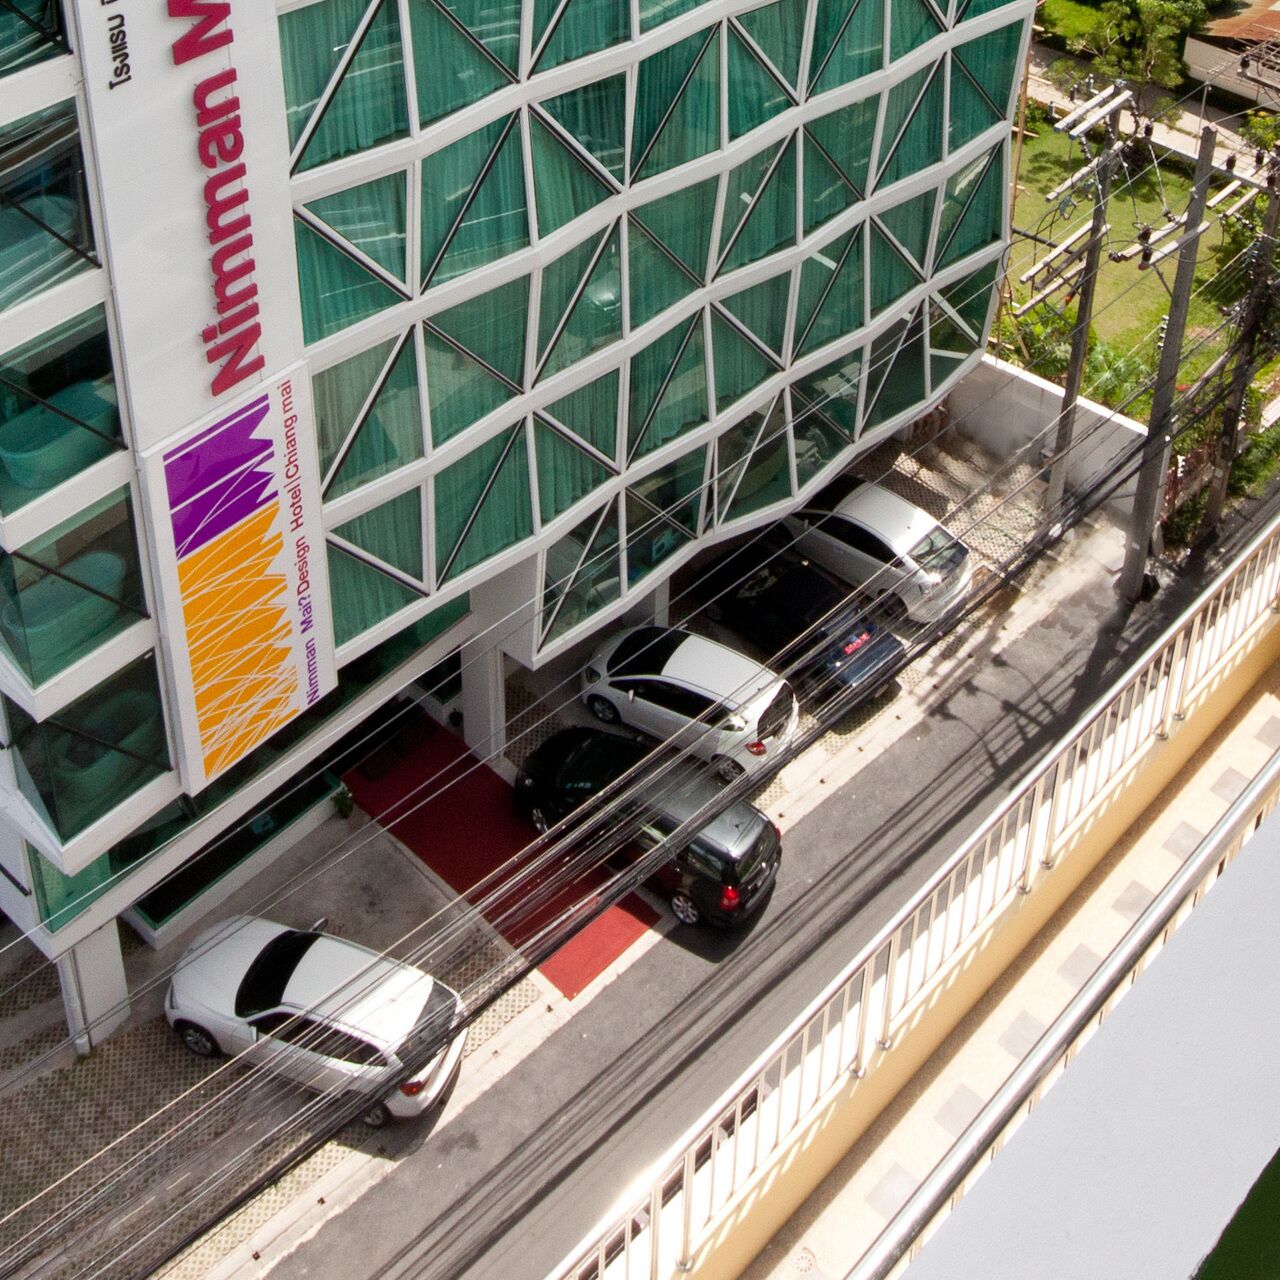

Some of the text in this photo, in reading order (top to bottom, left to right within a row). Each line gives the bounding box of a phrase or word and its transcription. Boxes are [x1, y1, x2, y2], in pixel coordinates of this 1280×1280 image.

[107, 13, 131, 90] โรงแรม
[193, 68, 265, 397] Nimman
[277, 379, 294, 414] mai
[294, 535, 310, 596] Design
[298, 594, 314, 635] Mai?
[305, 637, 320, 706] Nimman
